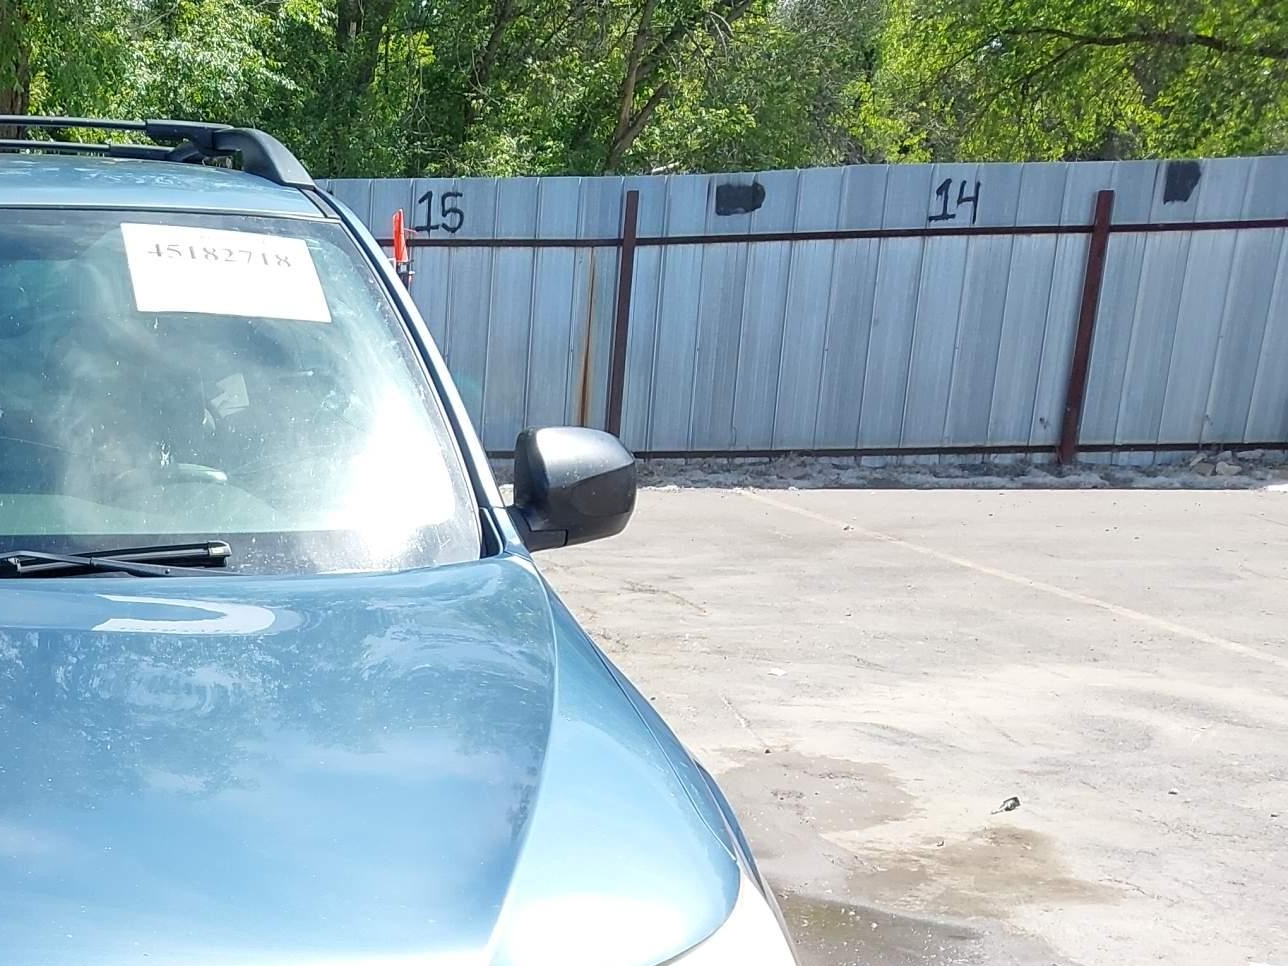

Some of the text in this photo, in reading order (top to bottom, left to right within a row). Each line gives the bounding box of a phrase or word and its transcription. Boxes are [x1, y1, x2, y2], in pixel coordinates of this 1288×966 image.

[415, 190, 464, 236] 15
[928, 178, 981, 224] 14
[147, 242, 292, 268] 45182718
